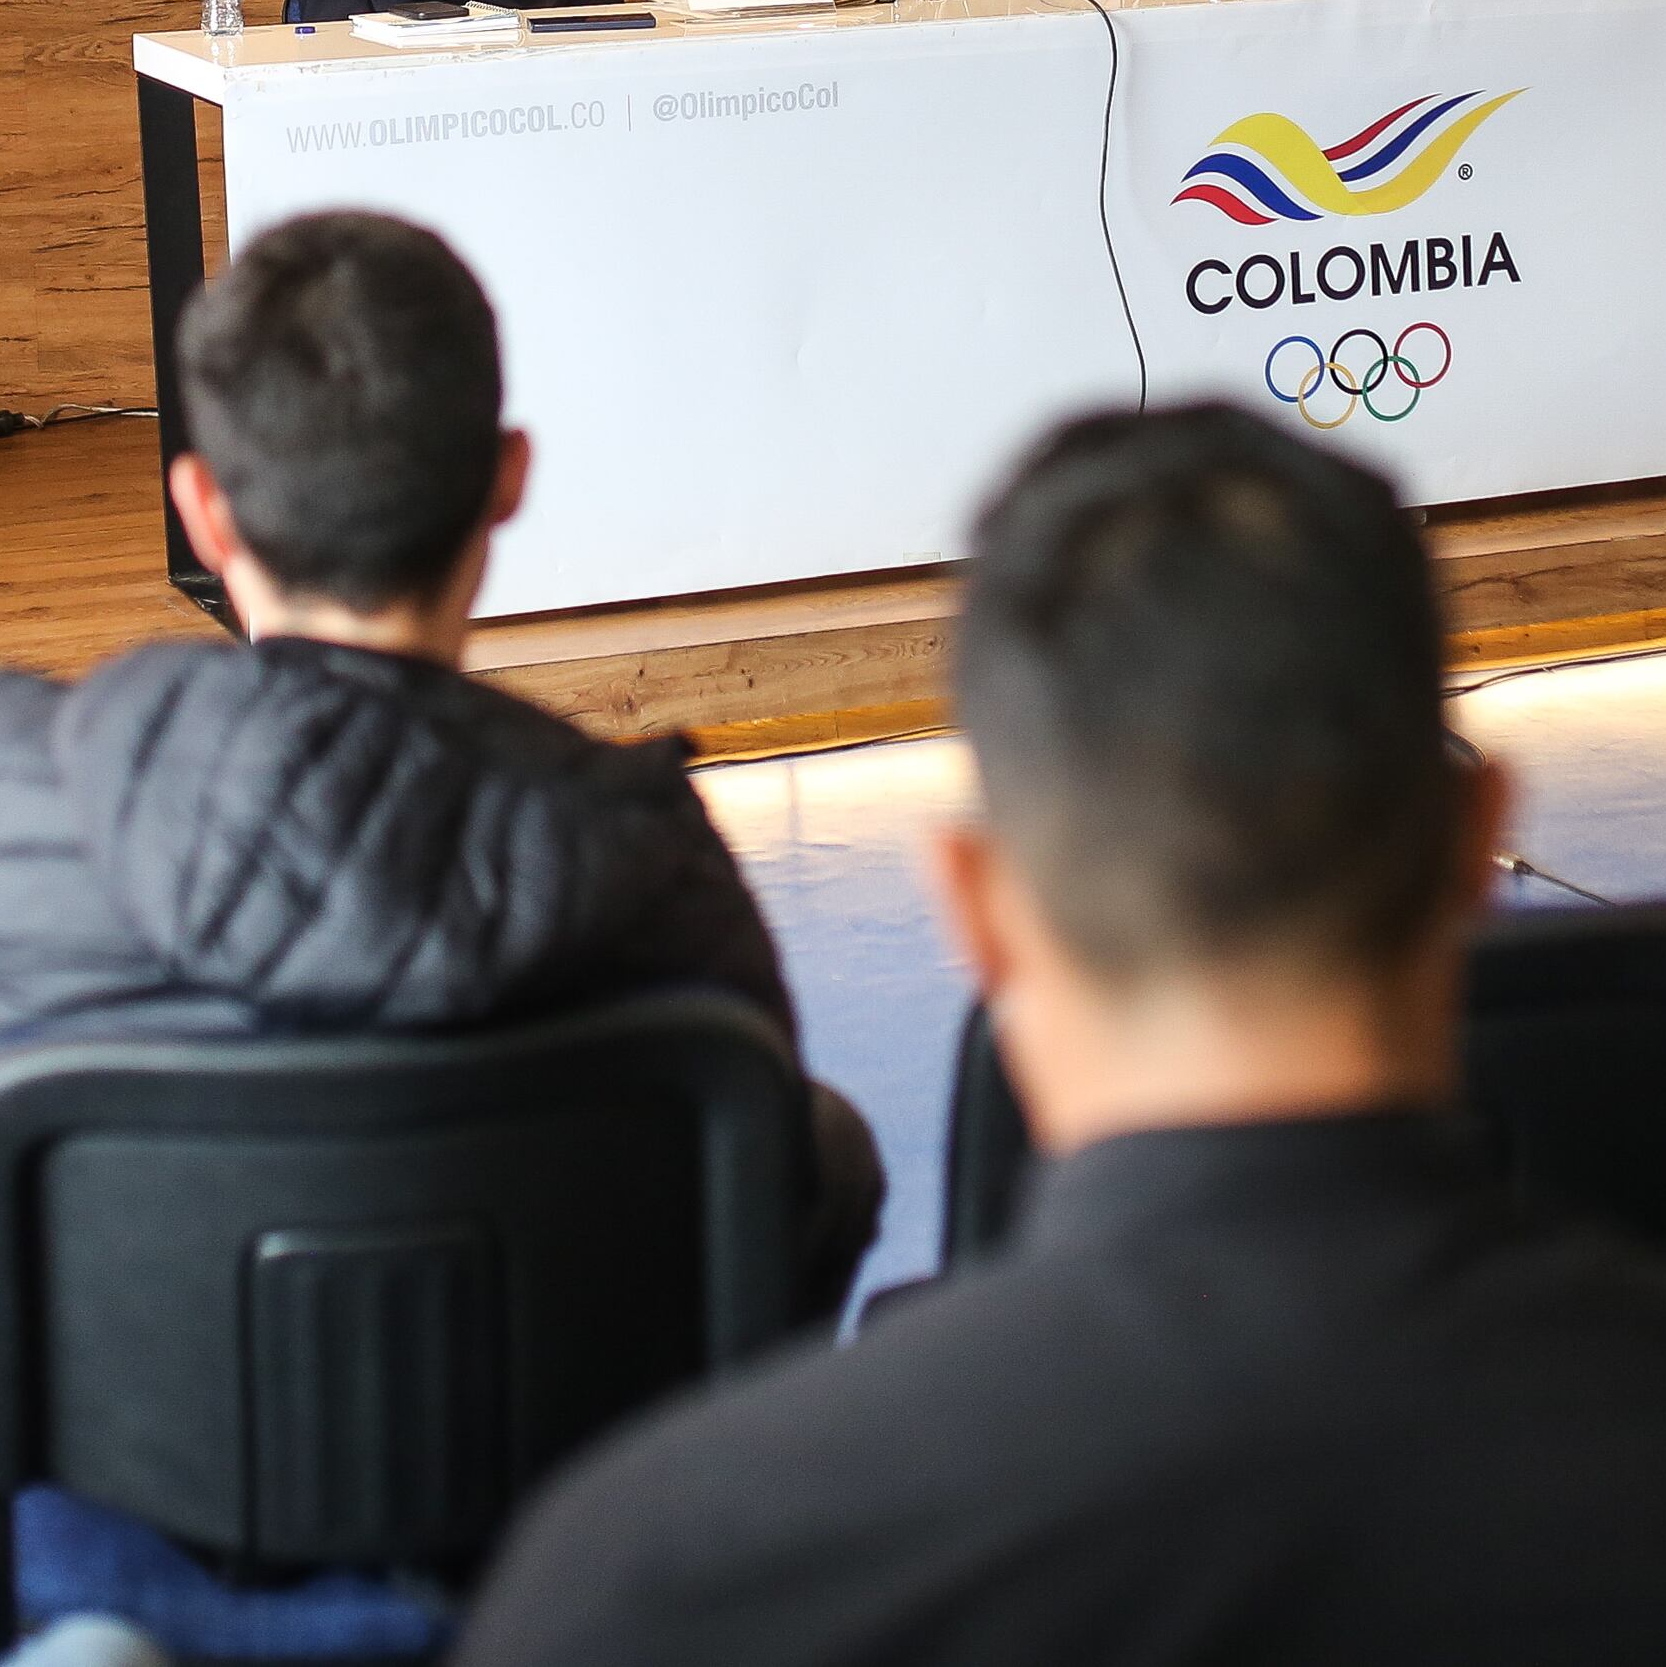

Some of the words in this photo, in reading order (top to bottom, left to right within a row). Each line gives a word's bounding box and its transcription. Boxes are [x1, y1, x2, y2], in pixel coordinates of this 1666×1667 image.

[286, 100, 606, 154] WWW.OLIMPICOCOL.CO
[652, 82, 839, 123] @OlimpicoCol
[1186, 232, 1521, 314] COLOMBIA
